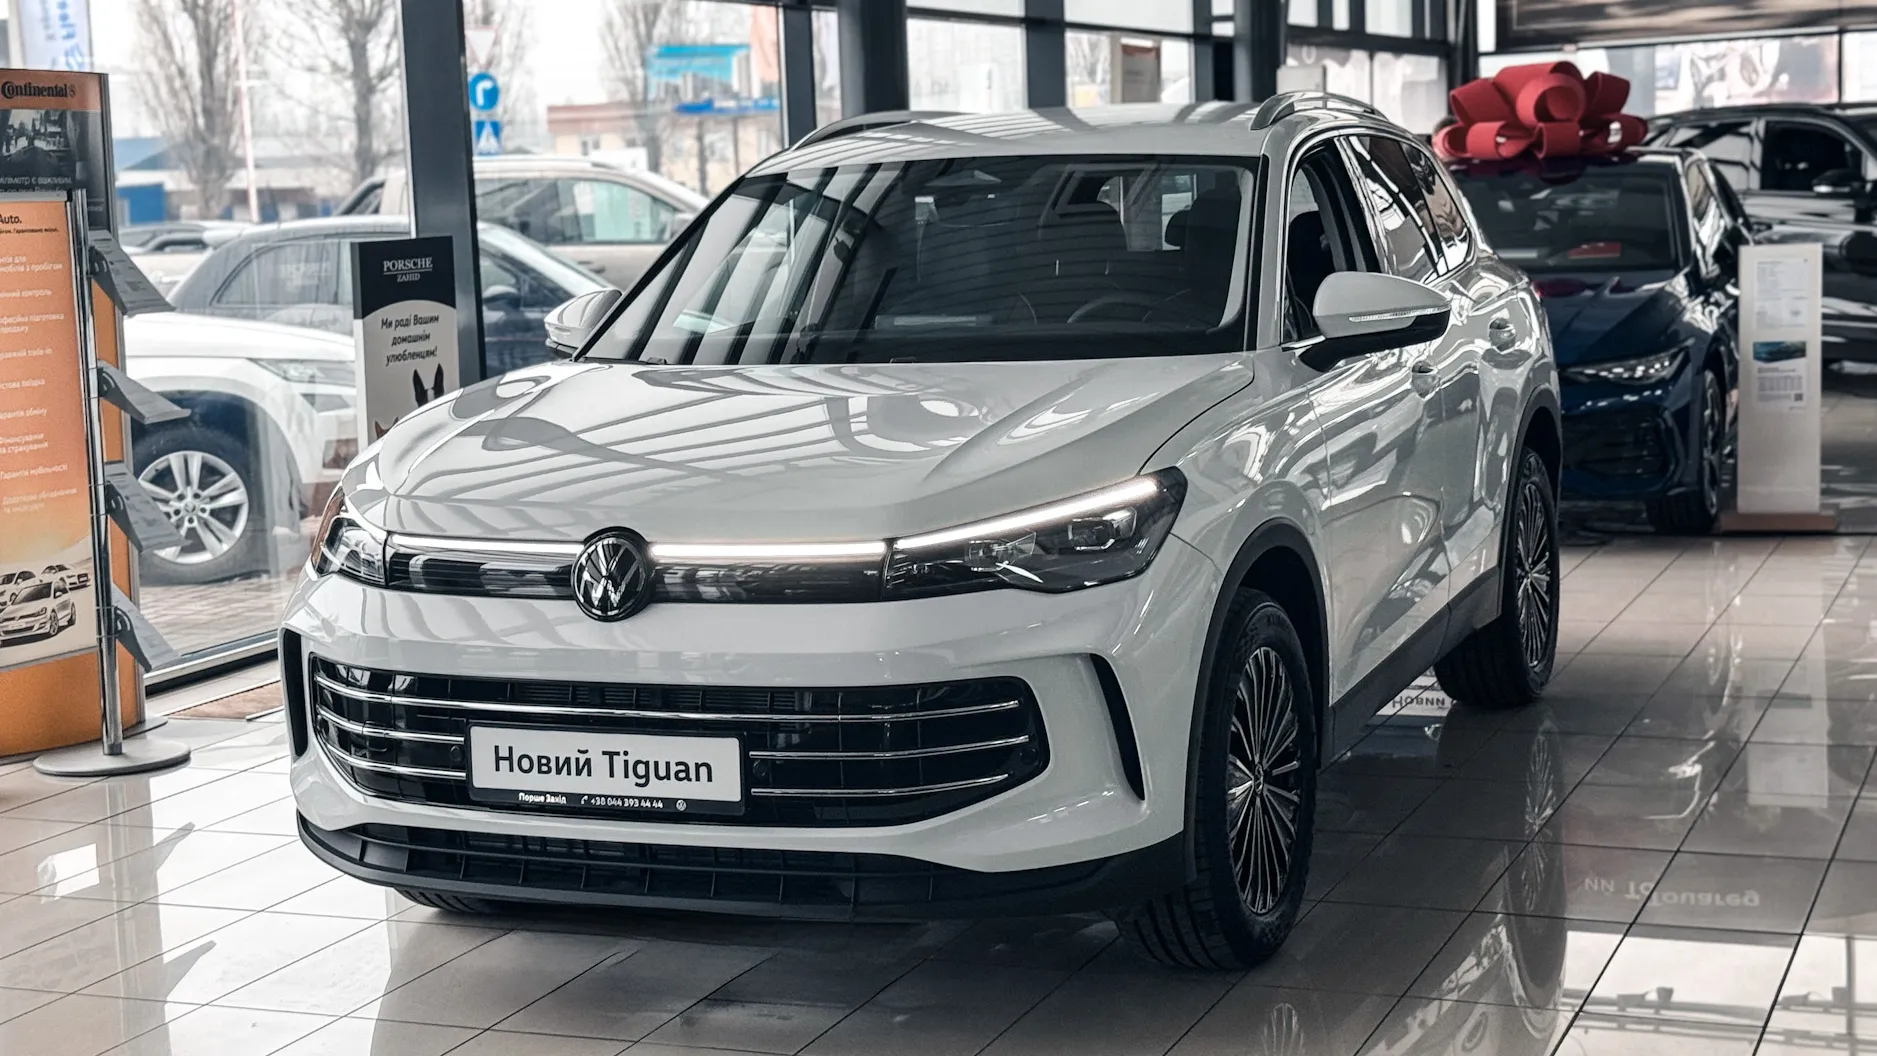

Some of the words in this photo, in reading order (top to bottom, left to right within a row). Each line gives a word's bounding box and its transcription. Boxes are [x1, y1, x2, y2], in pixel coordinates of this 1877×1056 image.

[1, 81, 68, 99] Continental
[383, 257, 433, 272] PORSCHE
[397, 273, 421, 283] ZAHID
[381, 317, 393, 330] Ми
[394, 314, 412, 328] раді
[413, 314, 439, 327] Вашим
[391, 330, 431, 347] домашнім
[386, 346, 438, 367] улюбленцям!
[493, 745, 592, 777] Новий
[601, 750, 713, 788] Tiguan
[518, 792, 545, 804] Порше
[545, 794, 567, 804] Захід
[590, 796, 605, 806] +38
[607, 797, 622, 807] 044
[623, 797, 639, 808] 393
[640, 798, 651, 808] 44
[652, 798, 663, 809] 44
